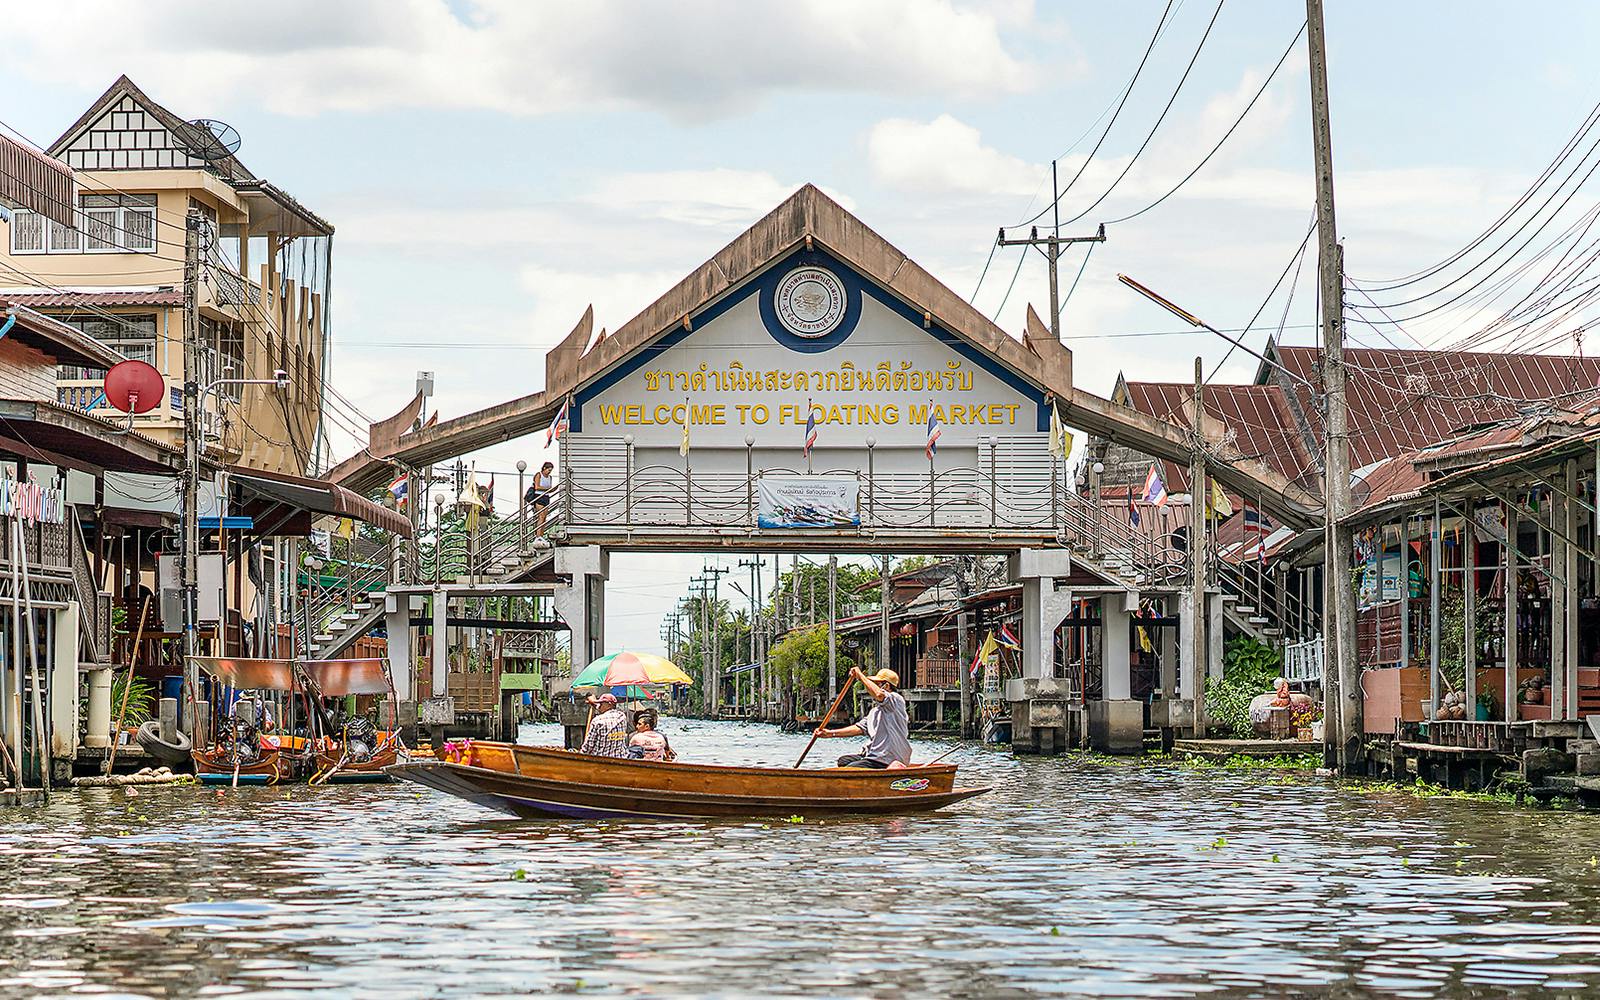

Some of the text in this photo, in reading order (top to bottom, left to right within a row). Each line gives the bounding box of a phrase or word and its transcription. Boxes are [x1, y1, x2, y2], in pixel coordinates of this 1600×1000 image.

[644, 360, 974, 392] ชาวดำเนินสะดวกยินดีต้อนรับ
[599, 403, 1020, 425] WELCOME TO FLOATING MARKET
